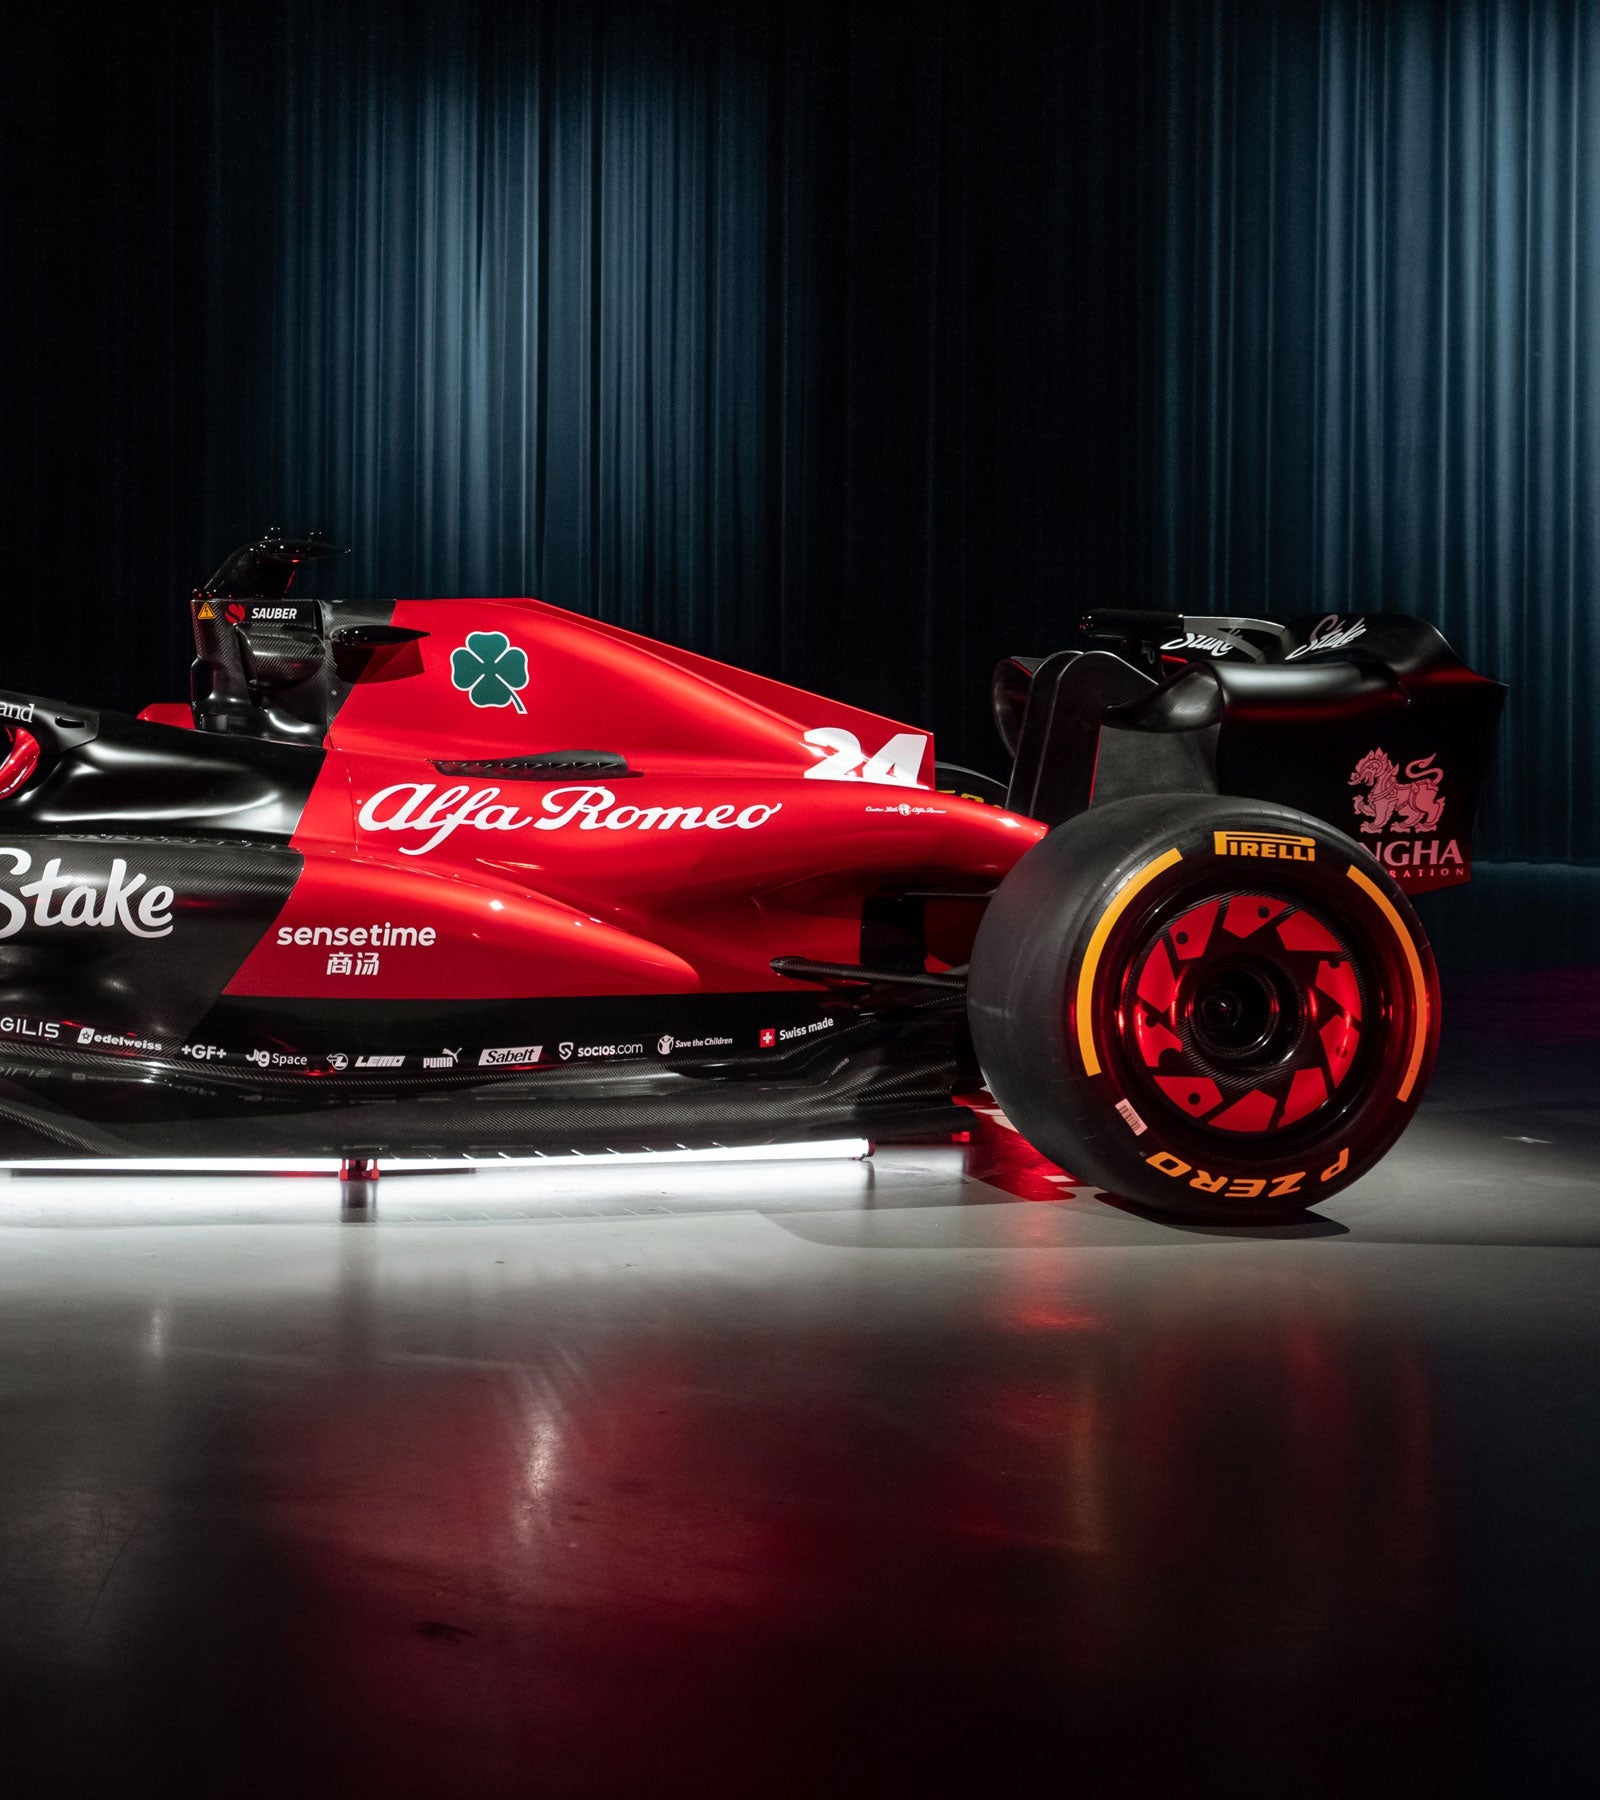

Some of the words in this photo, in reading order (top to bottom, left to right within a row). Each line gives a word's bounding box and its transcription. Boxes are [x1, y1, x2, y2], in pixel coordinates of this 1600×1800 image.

[251, 607, 298, 620] SAUBER
[1284, 614, 1367, 661] Stake
[803, 727, 930, 791] 24
[358, 783, 532, 855] Alfa
[532, 786, 784, 831] Romeo
[1213, 831, 1316, 861] PIRELLI
[1388, 868, 1464, 879] RATION
[276, 921, 437, 947] sensetime
[326, 951, 380, 976] 商汤
[779, 1026, 807, 1041] Swiss
[808, 1016, 834, 1033] made
[94, 1033, 163, 1051] edelweiss
[675, 1039, 692, 1048] Save
[692, 1038, 704, 1047] the
[704, 1036, 733, 1046] Children
[355, 1056, 406, 1068] LEMO
[423, 1057, 453, 1069] PUMA
[485, 1048, 535, 1064] Sabelt
[1146, 1151, 1306, 1197] ZERO
[1321, 1147, 1349, 1183] P
